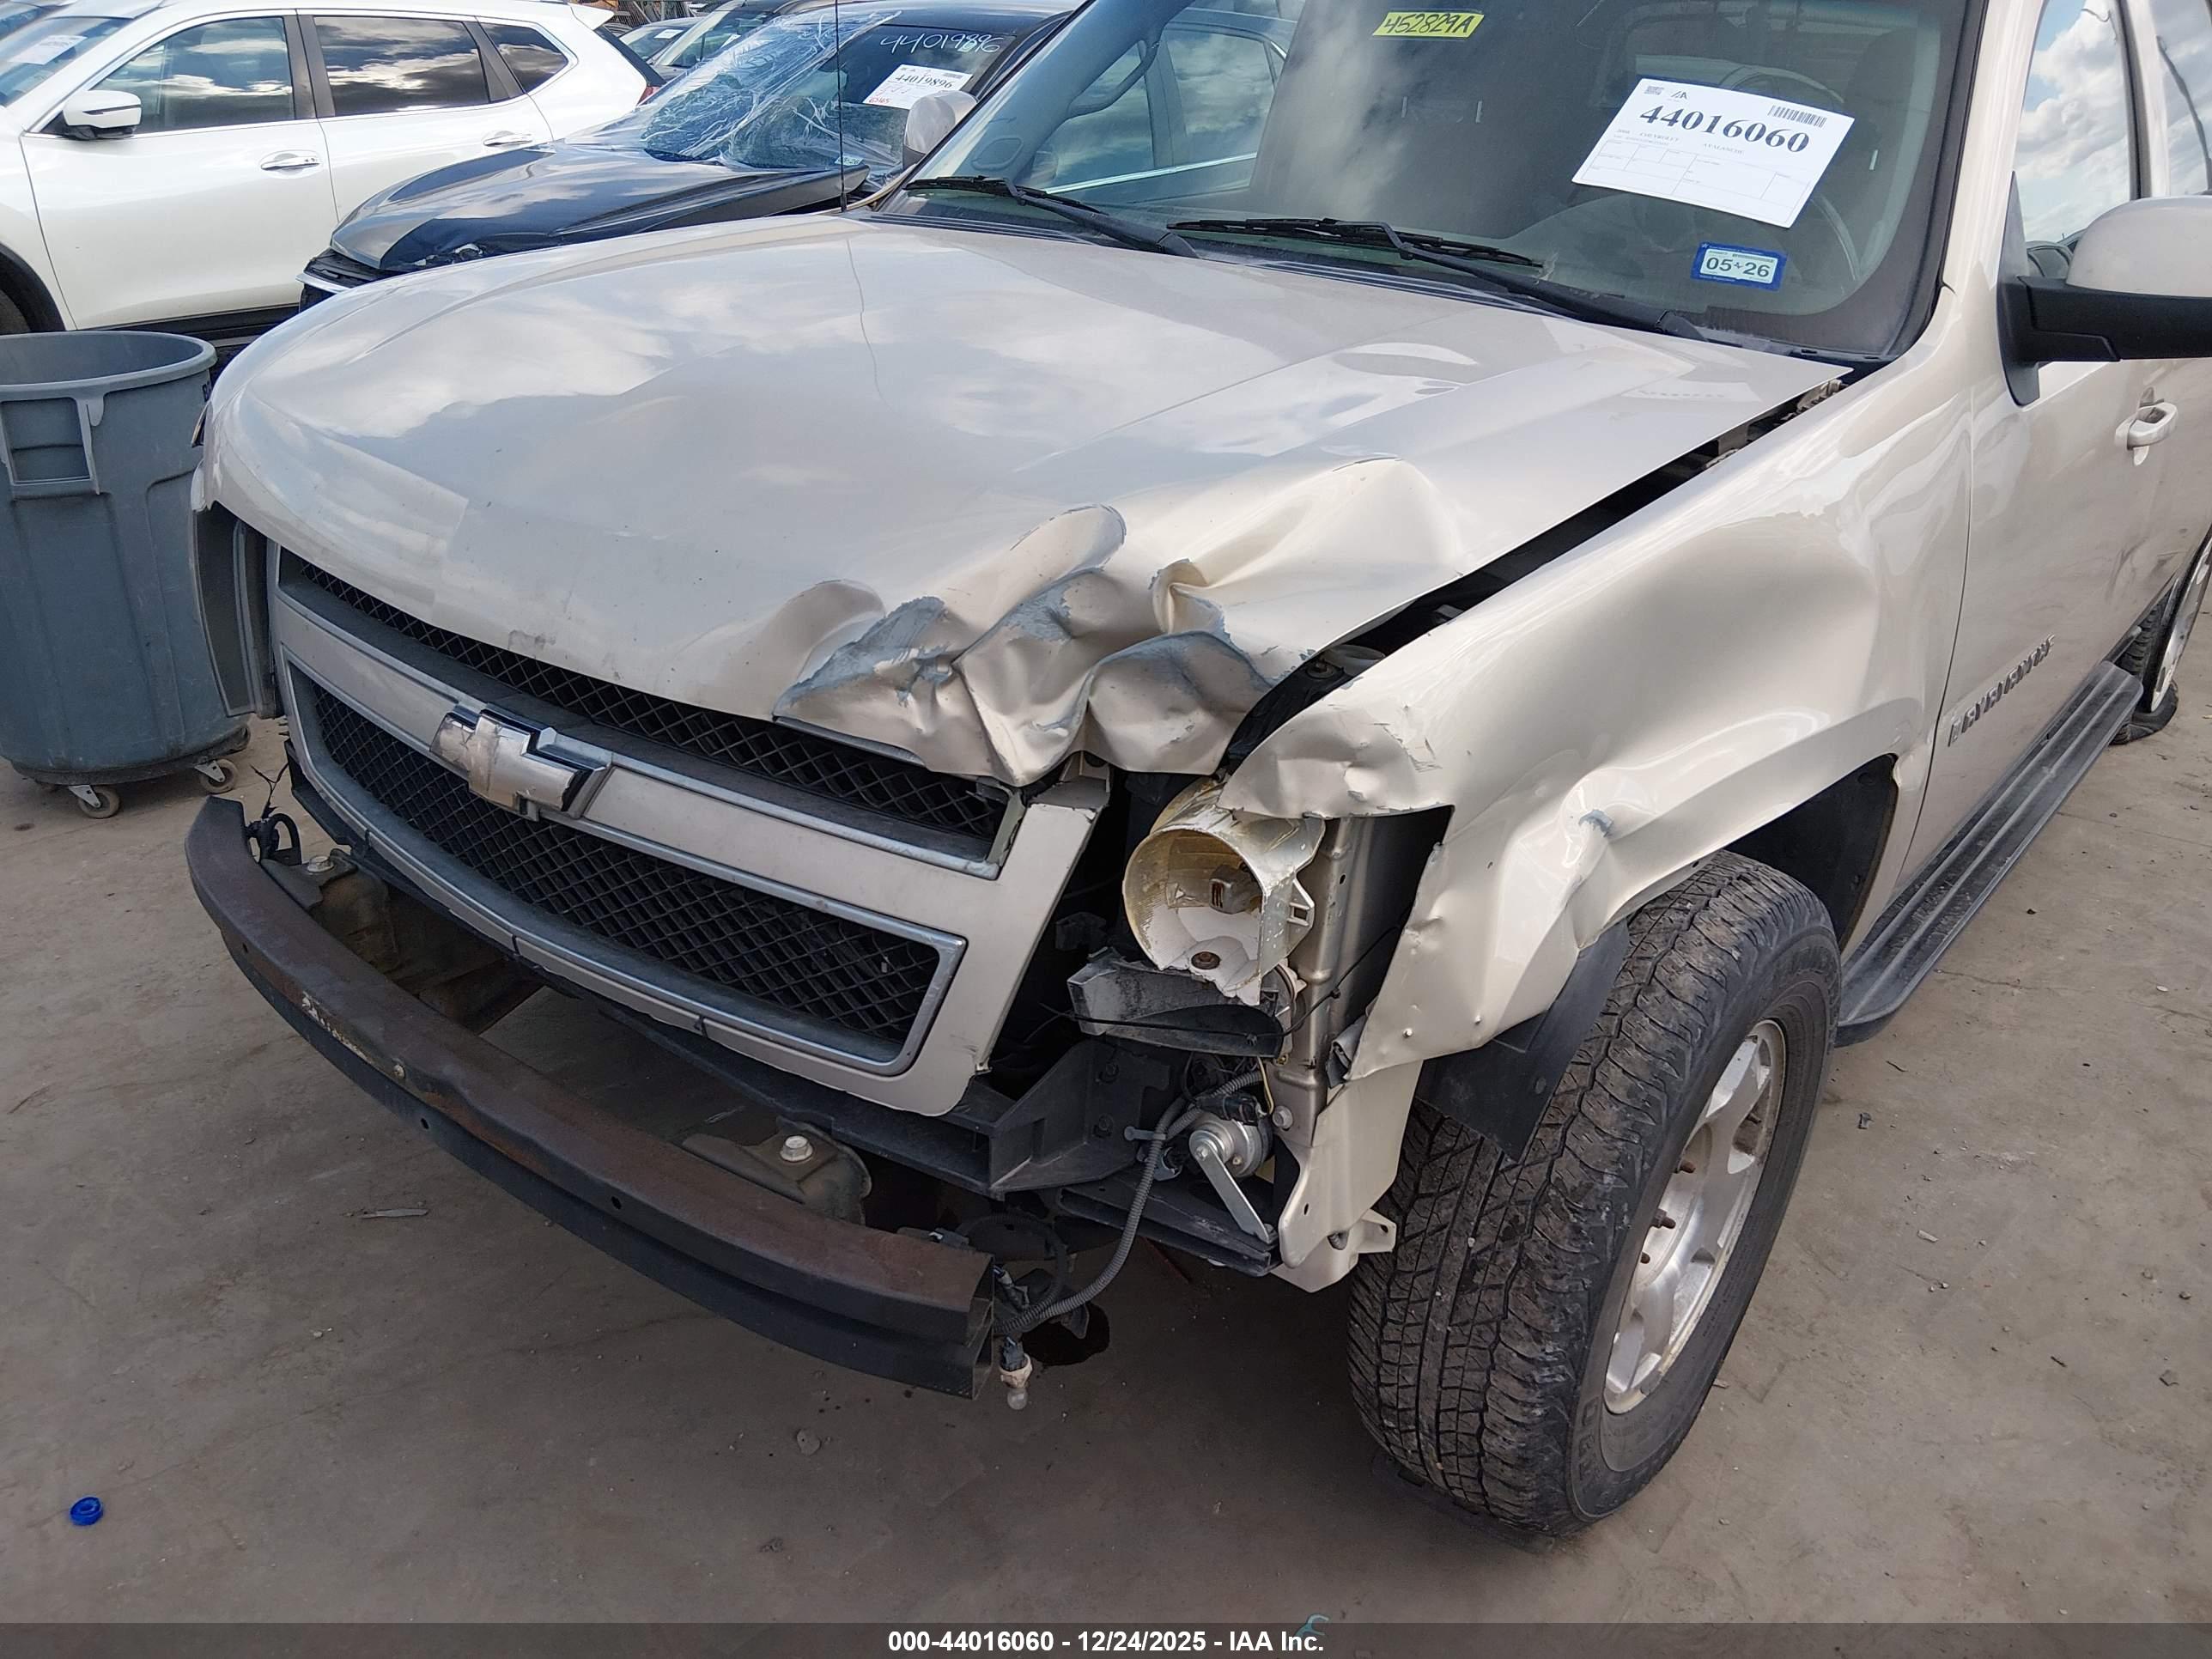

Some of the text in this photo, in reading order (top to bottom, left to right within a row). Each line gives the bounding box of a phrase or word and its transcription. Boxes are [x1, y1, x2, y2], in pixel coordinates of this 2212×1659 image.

[1384, 13, 1475, 33] 452829A
[880, 33, 1004, 53] 44019896
[1639, 105, 1810, 153] 44016060
[1706, 257, 1771, 277] 05 26
